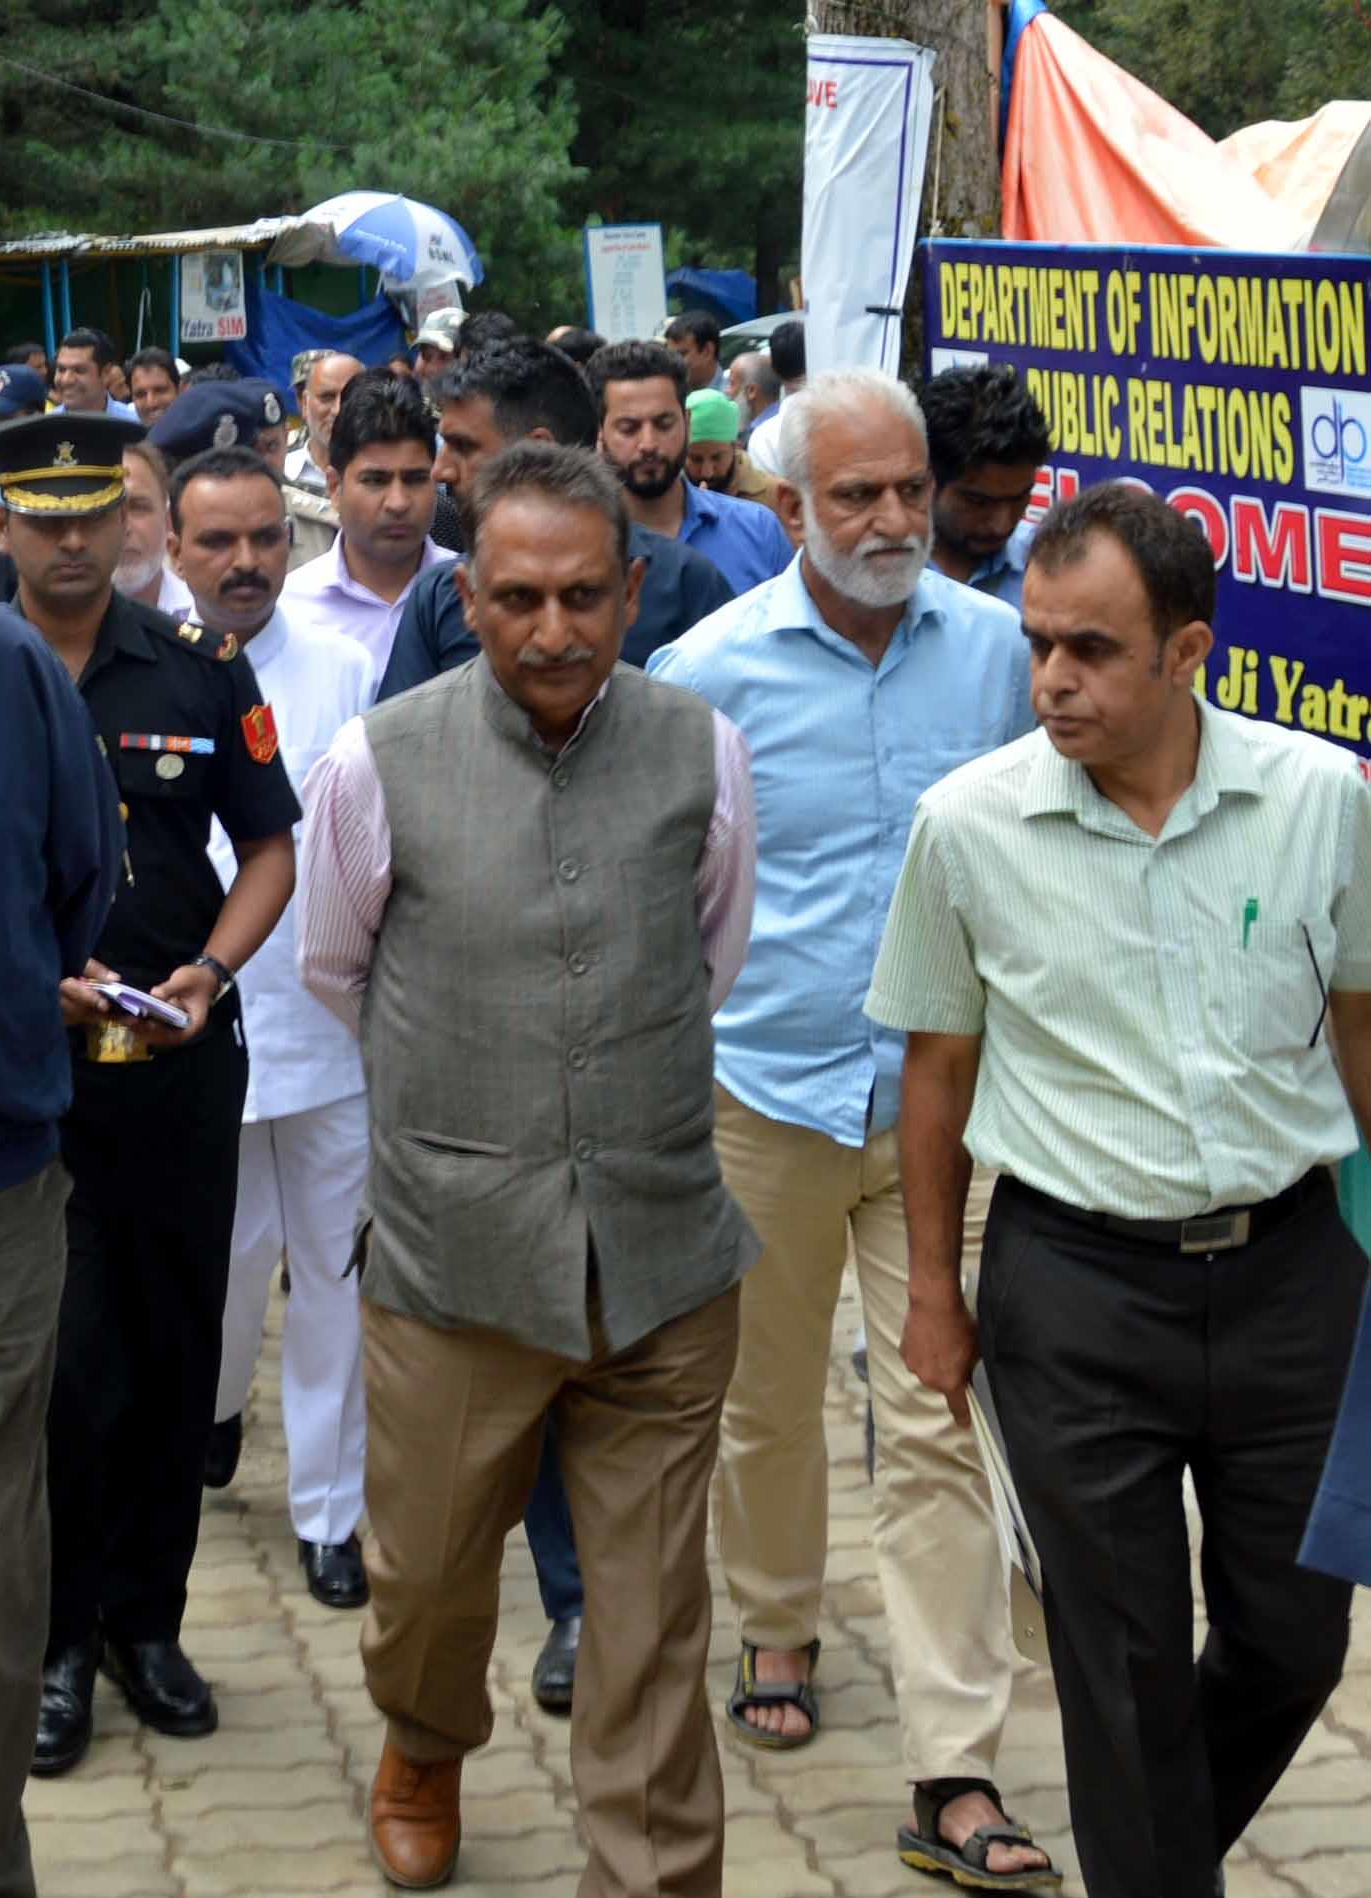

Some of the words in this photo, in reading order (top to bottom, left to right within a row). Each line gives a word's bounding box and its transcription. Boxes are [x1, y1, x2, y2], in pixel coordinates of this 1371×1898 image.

[217, 315, 245, 337] SIM
[939, 261, 1100, 353] DEPARTMENT
[1107, 268, 1143, 357] OF
[1148, 272, 1368, 376] INFORMATION
[1127, 376, 1295, 485] RELATIONS
[1216, 645, 1259, 715] Ji
[1269, 655, 1371, 743] Yatr
